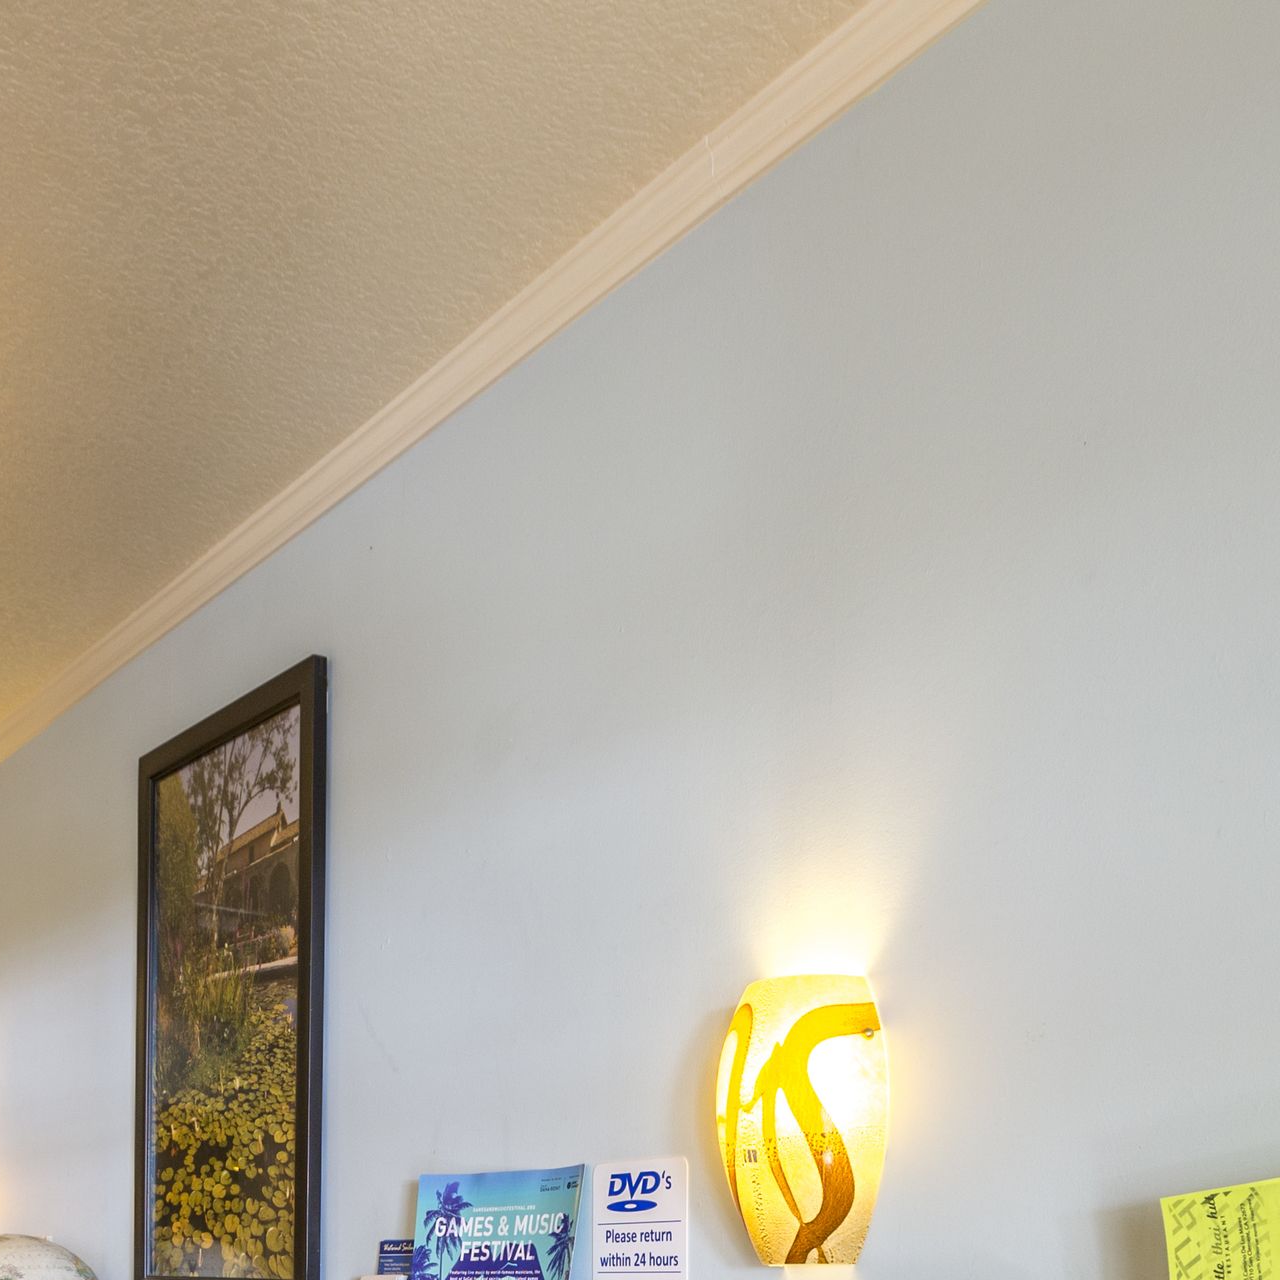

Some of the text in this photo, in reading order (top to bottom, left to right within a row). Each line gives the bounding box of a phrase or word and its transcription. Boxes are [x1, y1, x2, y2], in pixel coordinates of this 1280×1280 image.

[435, 1212, 565, 1237] GAMES & MUSIC
[606, 1230, 672, 1243] Please return
[1210, 1225, 1223, 1255] thai
[1220, 1215, 1231, 1274] RESTAURANT
[460, 1240, 535, 1261] FESTIVAL
[600, 1253, 678, 1267] within 24 hours
